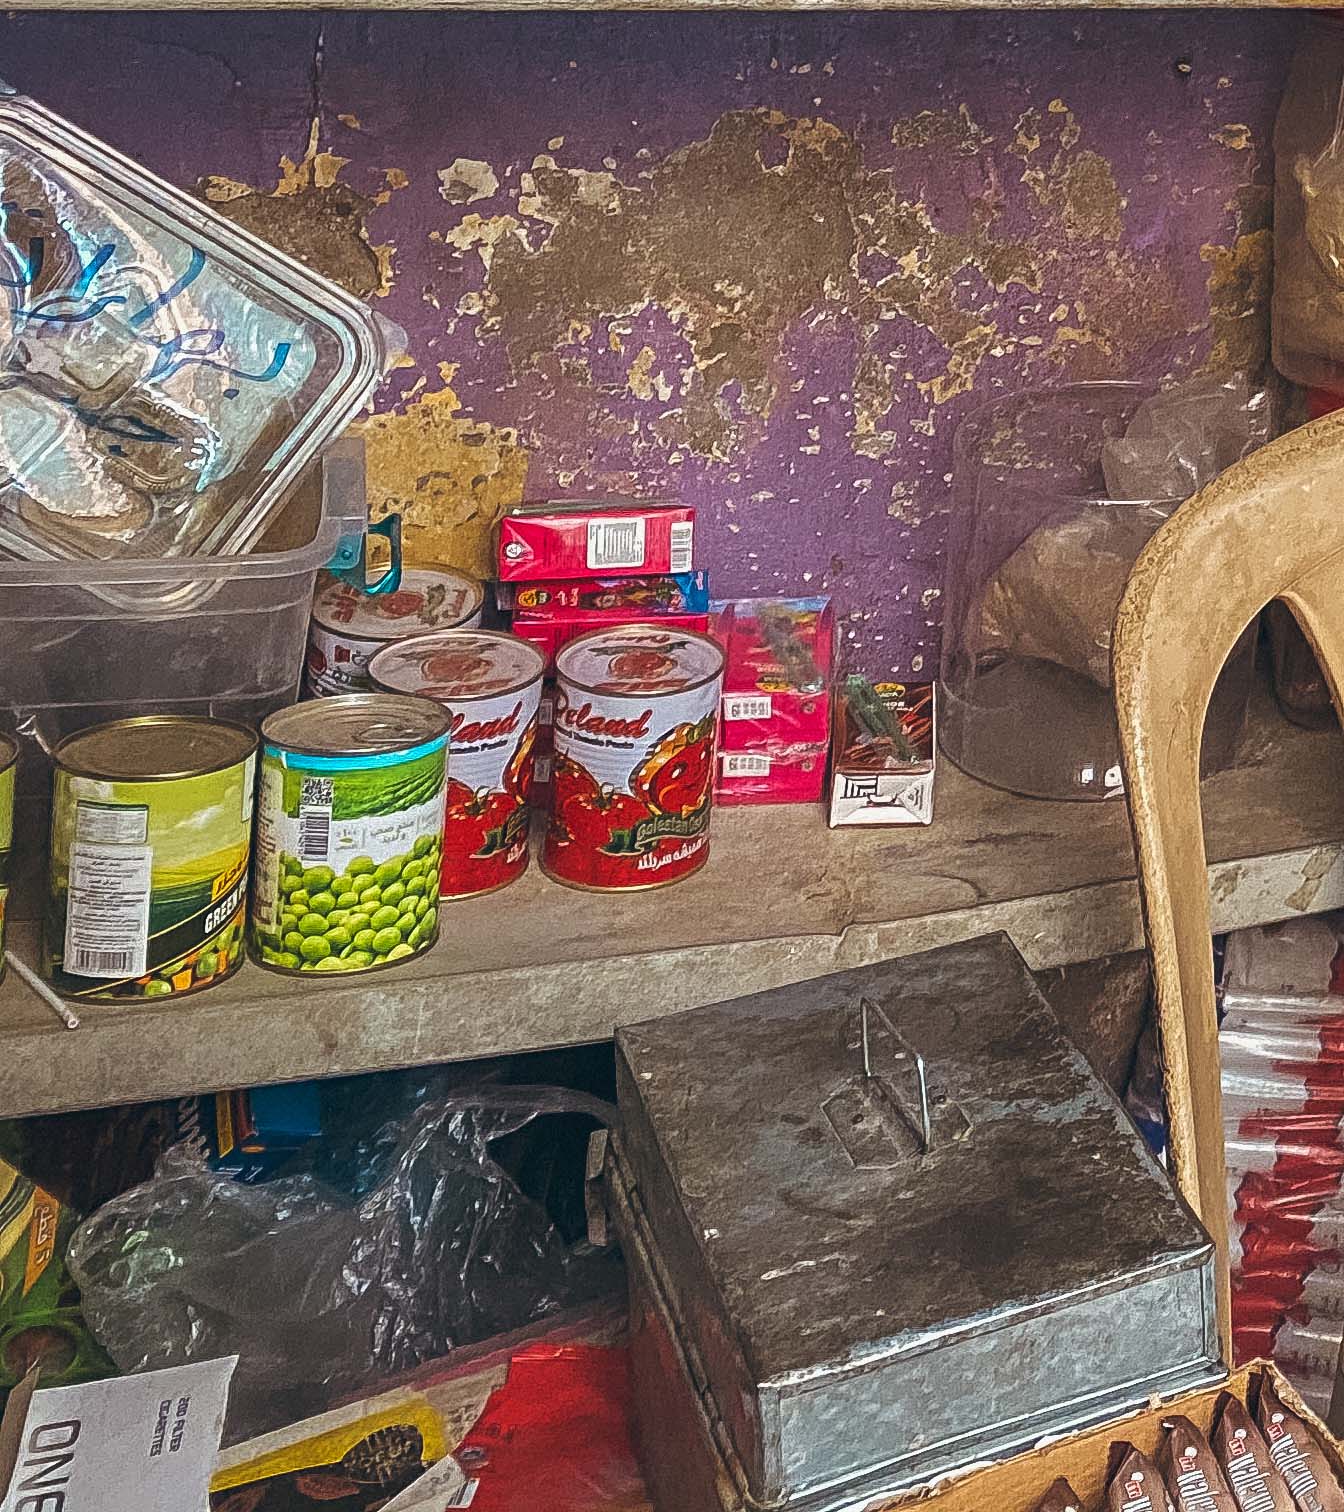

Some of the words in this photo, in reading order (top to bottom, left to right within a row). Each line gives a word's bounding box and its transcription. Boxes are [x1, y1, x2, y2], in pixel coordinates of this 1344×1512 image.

[204, 889, 238, 935] GREEN
[149, 1399, 173, 1457] CIGARETTES
[175, 1396, 191, 1417] 200
[168, 1419, 186, 1454] FILTER
[14, 1419, 82, 1512] ONE
